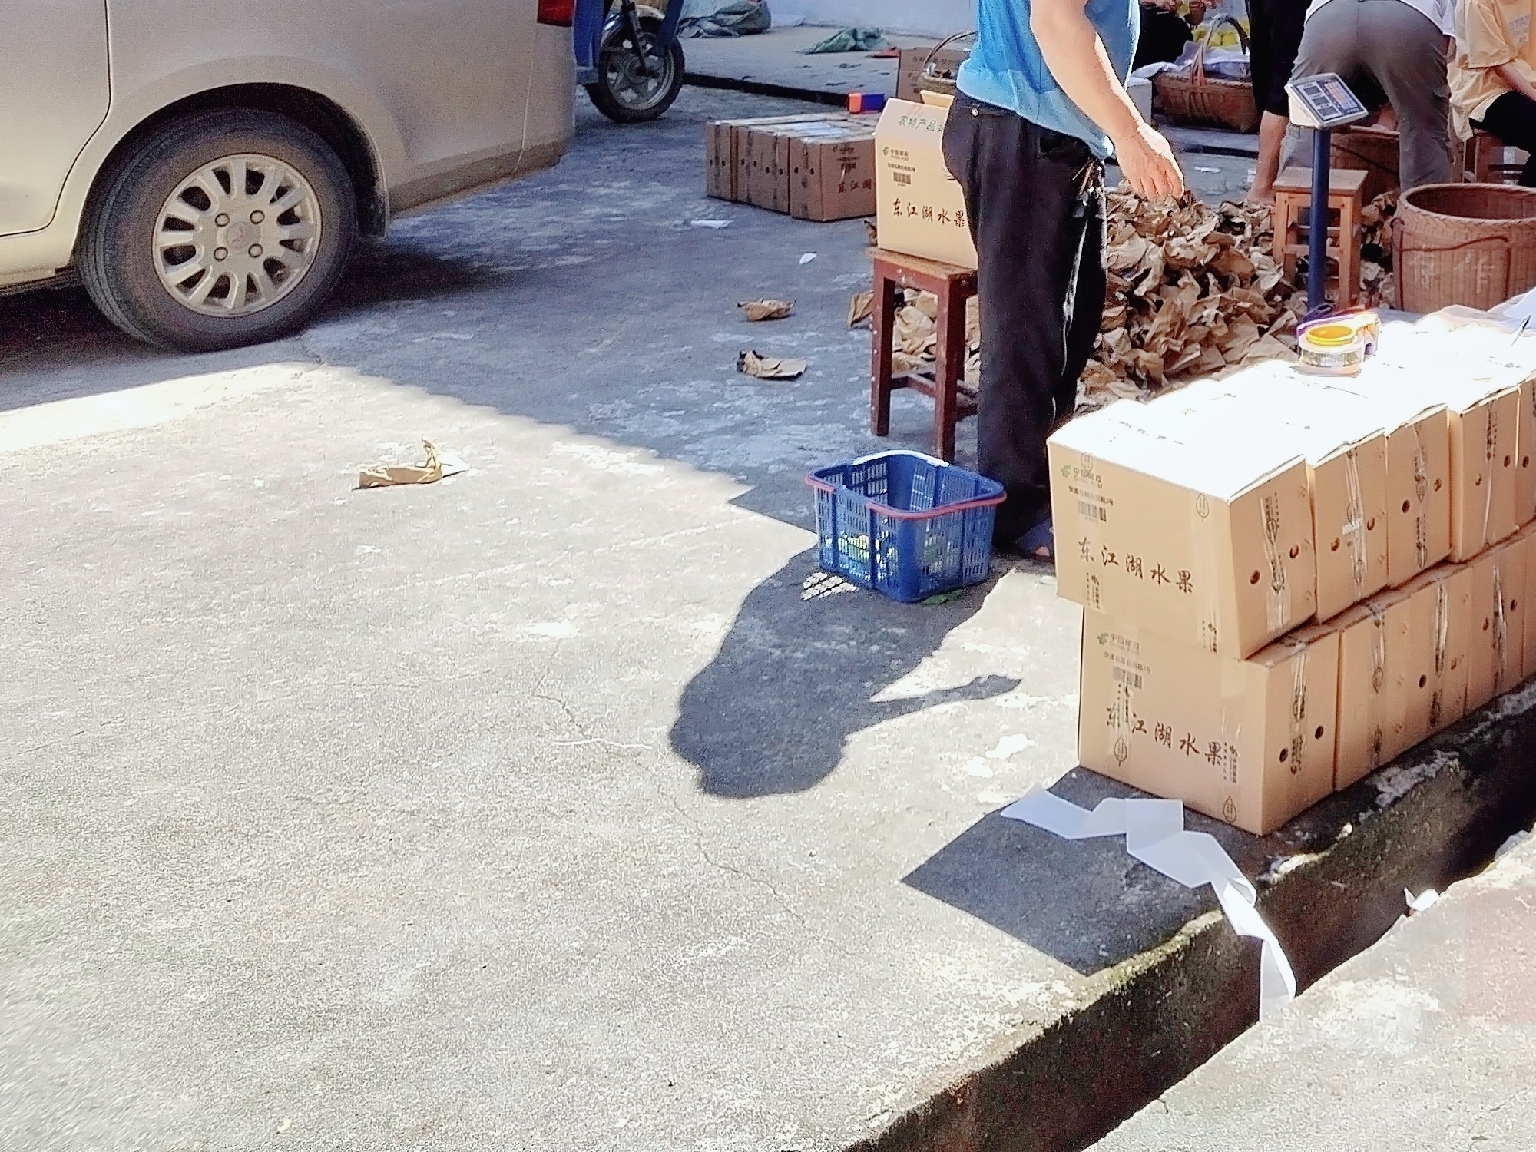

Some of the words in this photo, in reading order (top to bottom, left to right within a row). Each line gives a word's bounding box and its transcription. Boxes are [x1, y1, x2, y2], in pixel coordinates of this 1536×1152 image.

[893, 197, 965, 228] 东江湖水果
[1078, 536, 1194, 594] 东江湖水果
[1106, 703, 1223, 766] 东江湖水果
